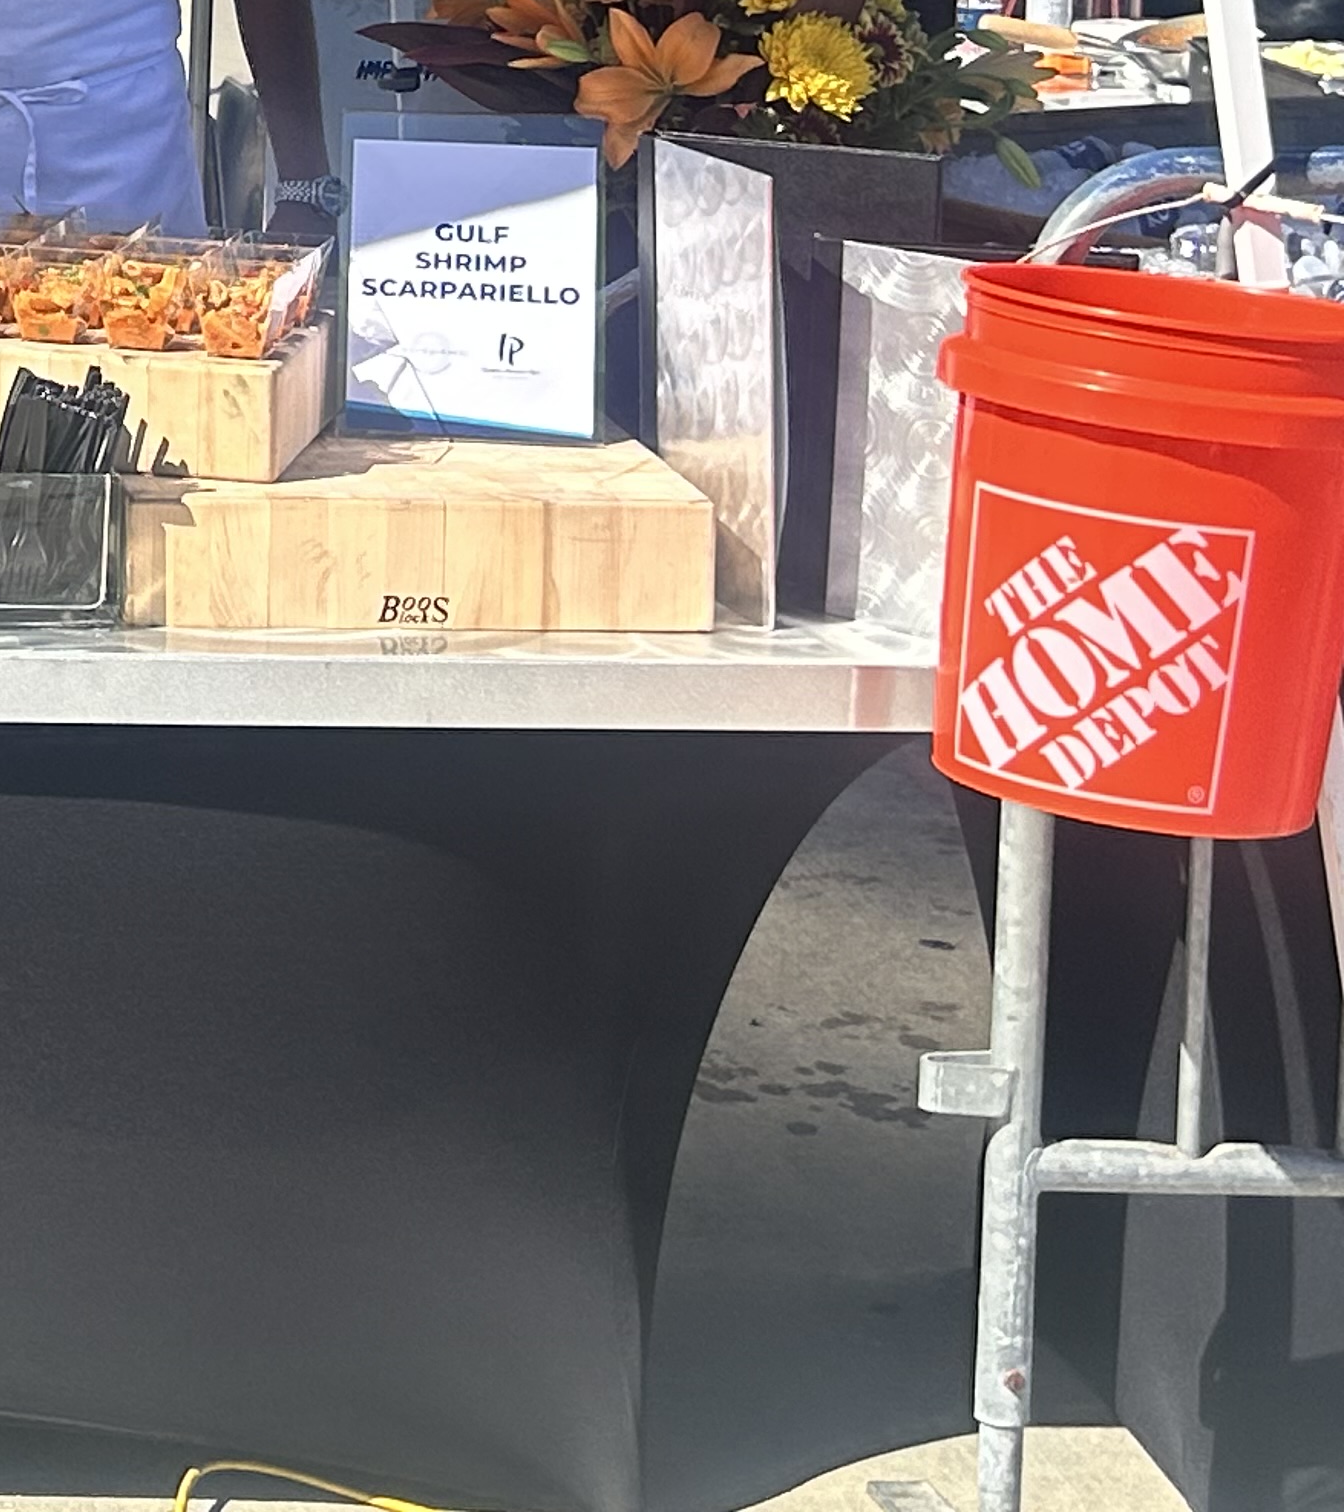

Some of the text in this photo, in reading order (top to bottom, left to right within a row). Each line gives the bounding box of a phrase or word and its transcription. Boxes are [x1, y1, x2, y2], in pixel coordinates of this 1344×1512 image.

[415, 251, 527, 274] SHRIMP
[434, 222, 510, 245] GULF
[361, 277, 581, 306] SCARPARIELLO
[983, 534, 1098, 637] THE
[960, 525, 1246, 772] HOME
[1038, 633, 1230, 791] DEPOT
